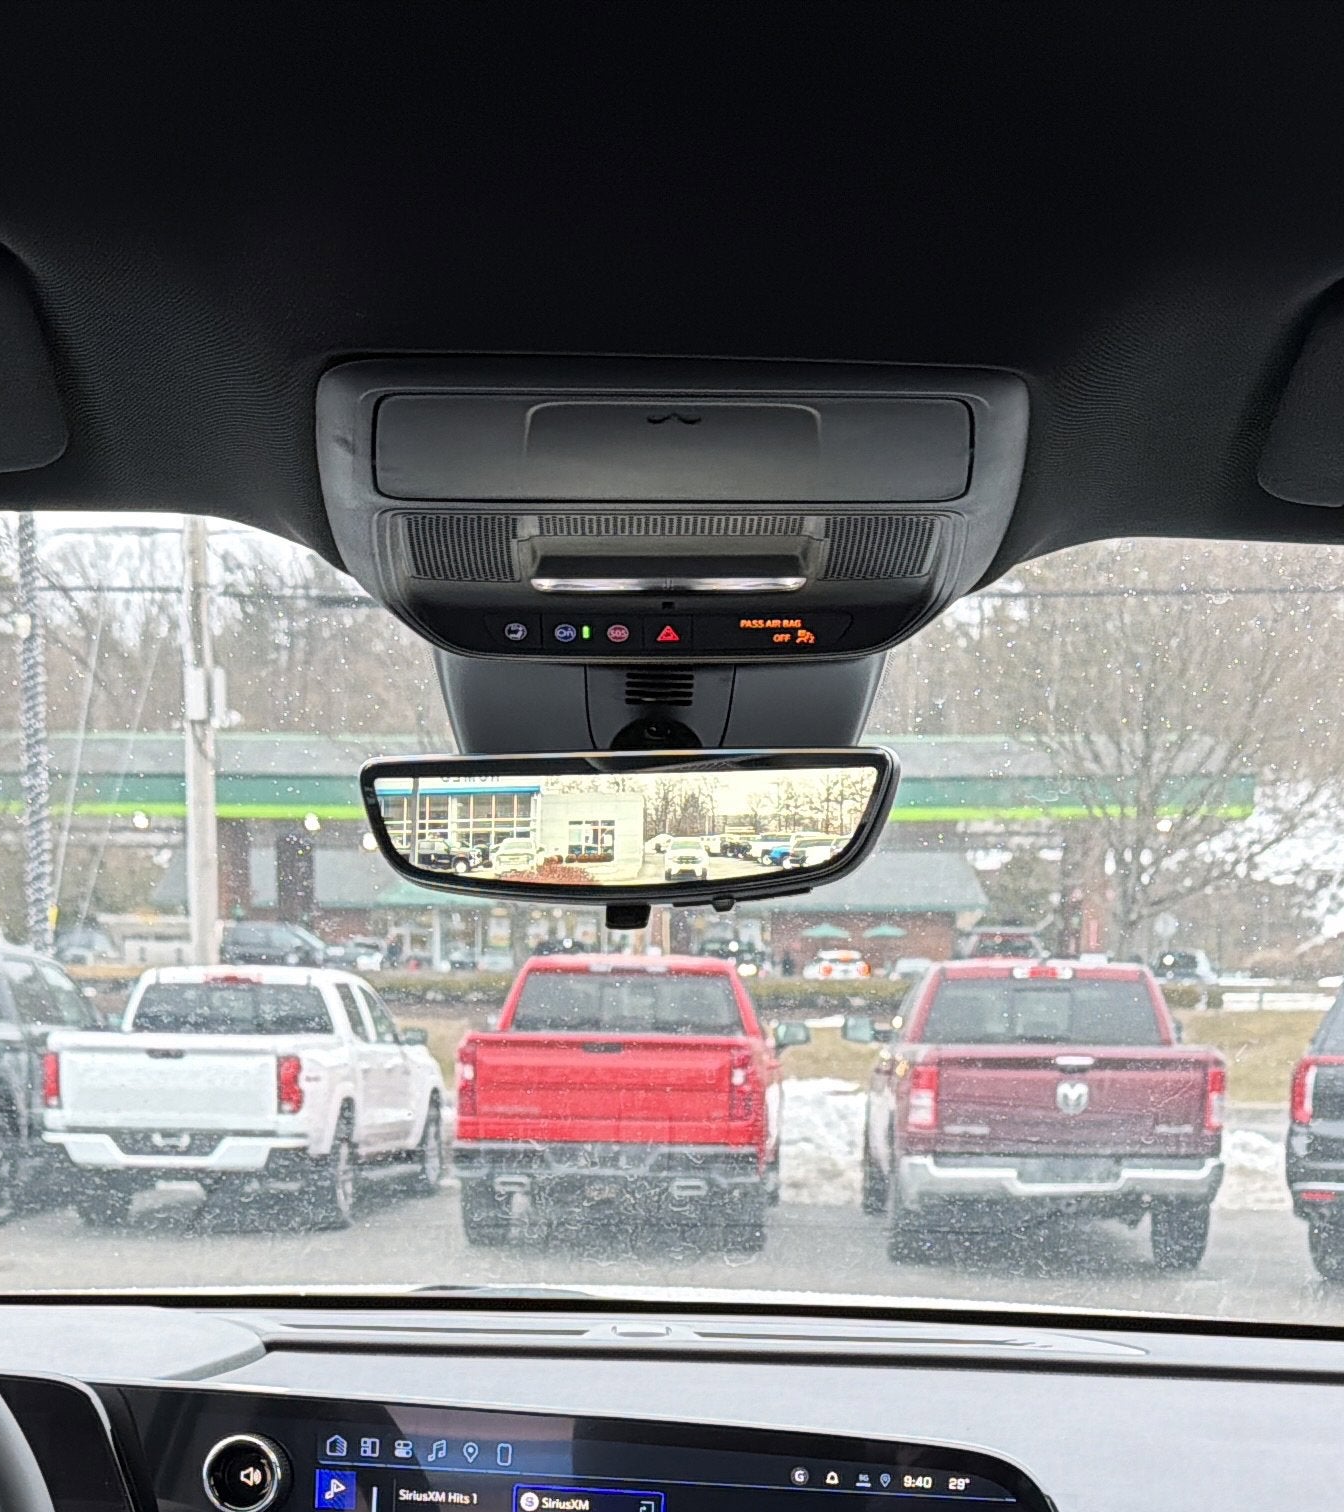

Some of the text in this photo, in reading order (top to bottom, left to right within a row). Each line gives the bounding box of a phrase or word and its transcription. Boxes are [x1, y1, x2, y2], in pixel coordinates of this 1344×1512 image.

[740, 619, 802, 629] PASS AIR BAG
[610, 629, 628, 638] SOS
[773, 633, 791, 643] OFF
[903, 1475, 971, 1490] 9:40 29°
[398, 1489, 478, 1504] SiriusXM Hits 1
[541, 1497, 590, 1511] SiriusXM
